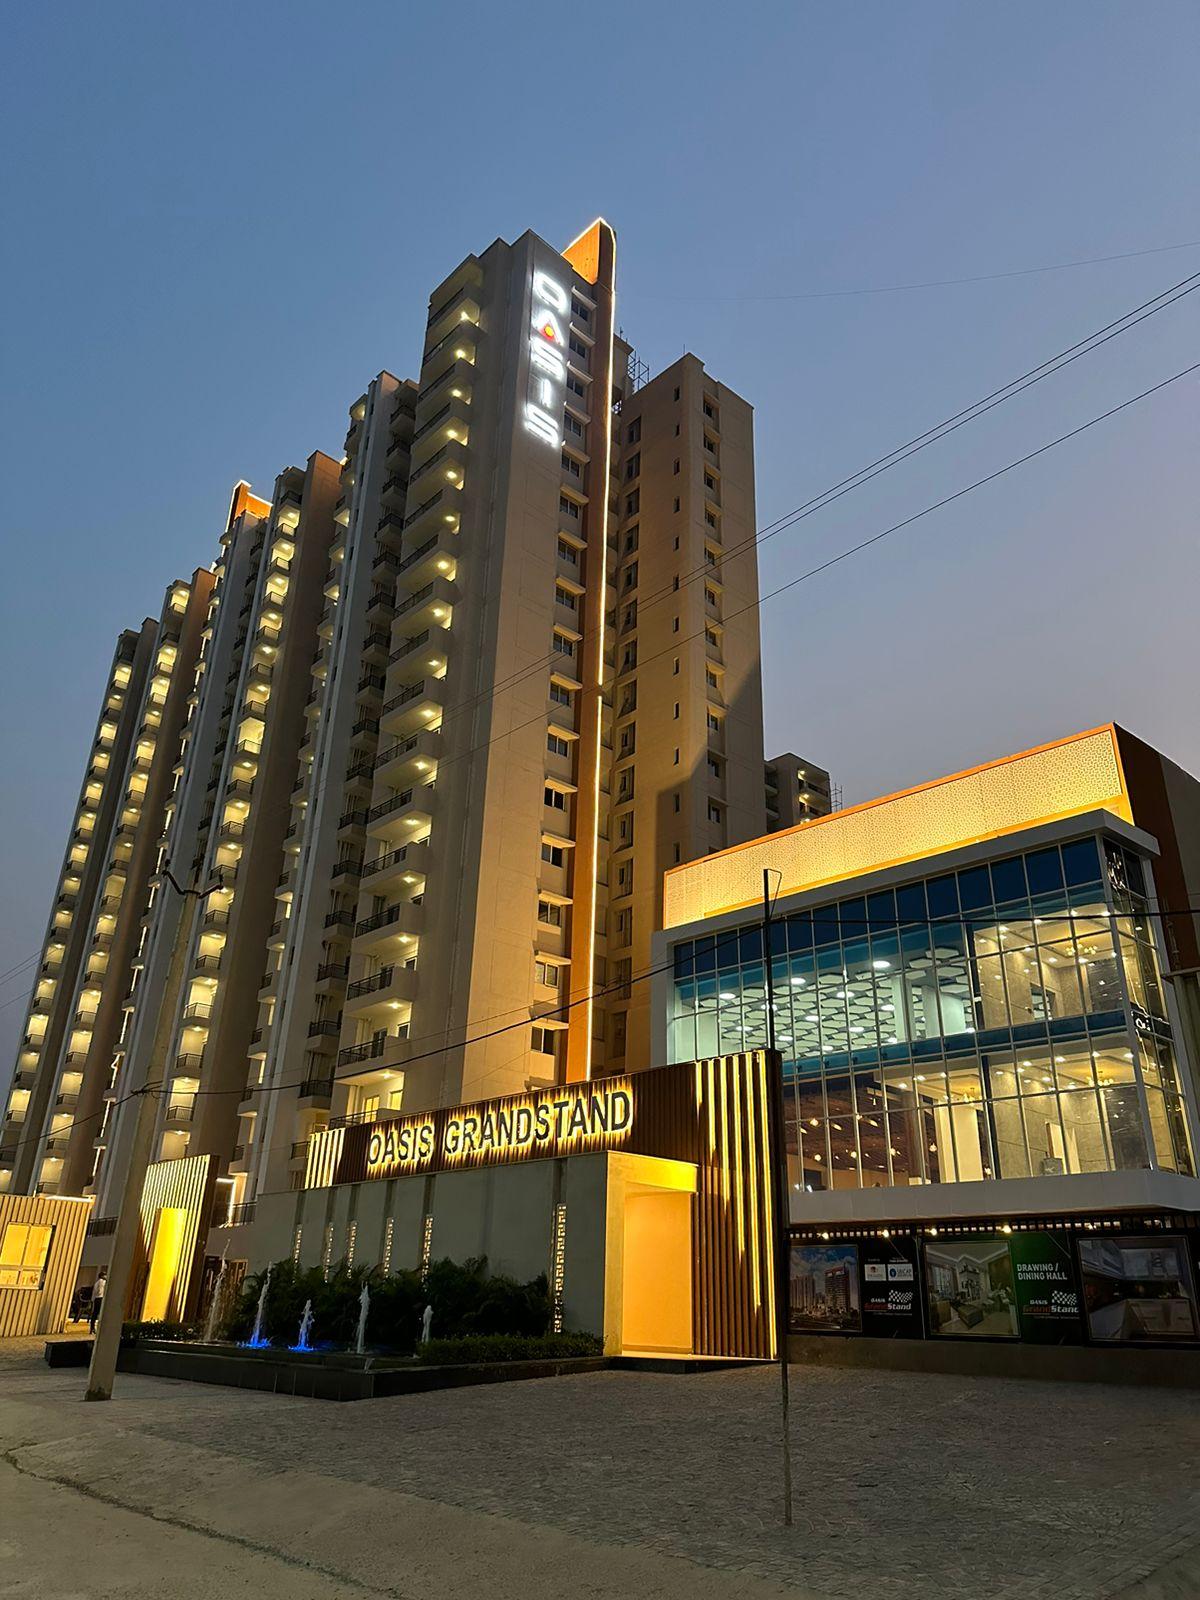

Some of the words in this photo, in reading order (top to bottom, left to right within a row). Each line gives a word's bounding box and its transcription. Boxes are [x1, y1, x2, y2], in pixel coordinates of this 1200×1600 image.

[525, 271, 567, 447] OASIS
[368, 1125, 433, 1165] OASIS
[444, 1091, 632, 1155] GRANDSTAND
[1016, 1263, 1053, 1272] DRAWING
[1017, 1271, 1045, 1280] DINING
[1046, 1271, 1068, 1280] HALL
